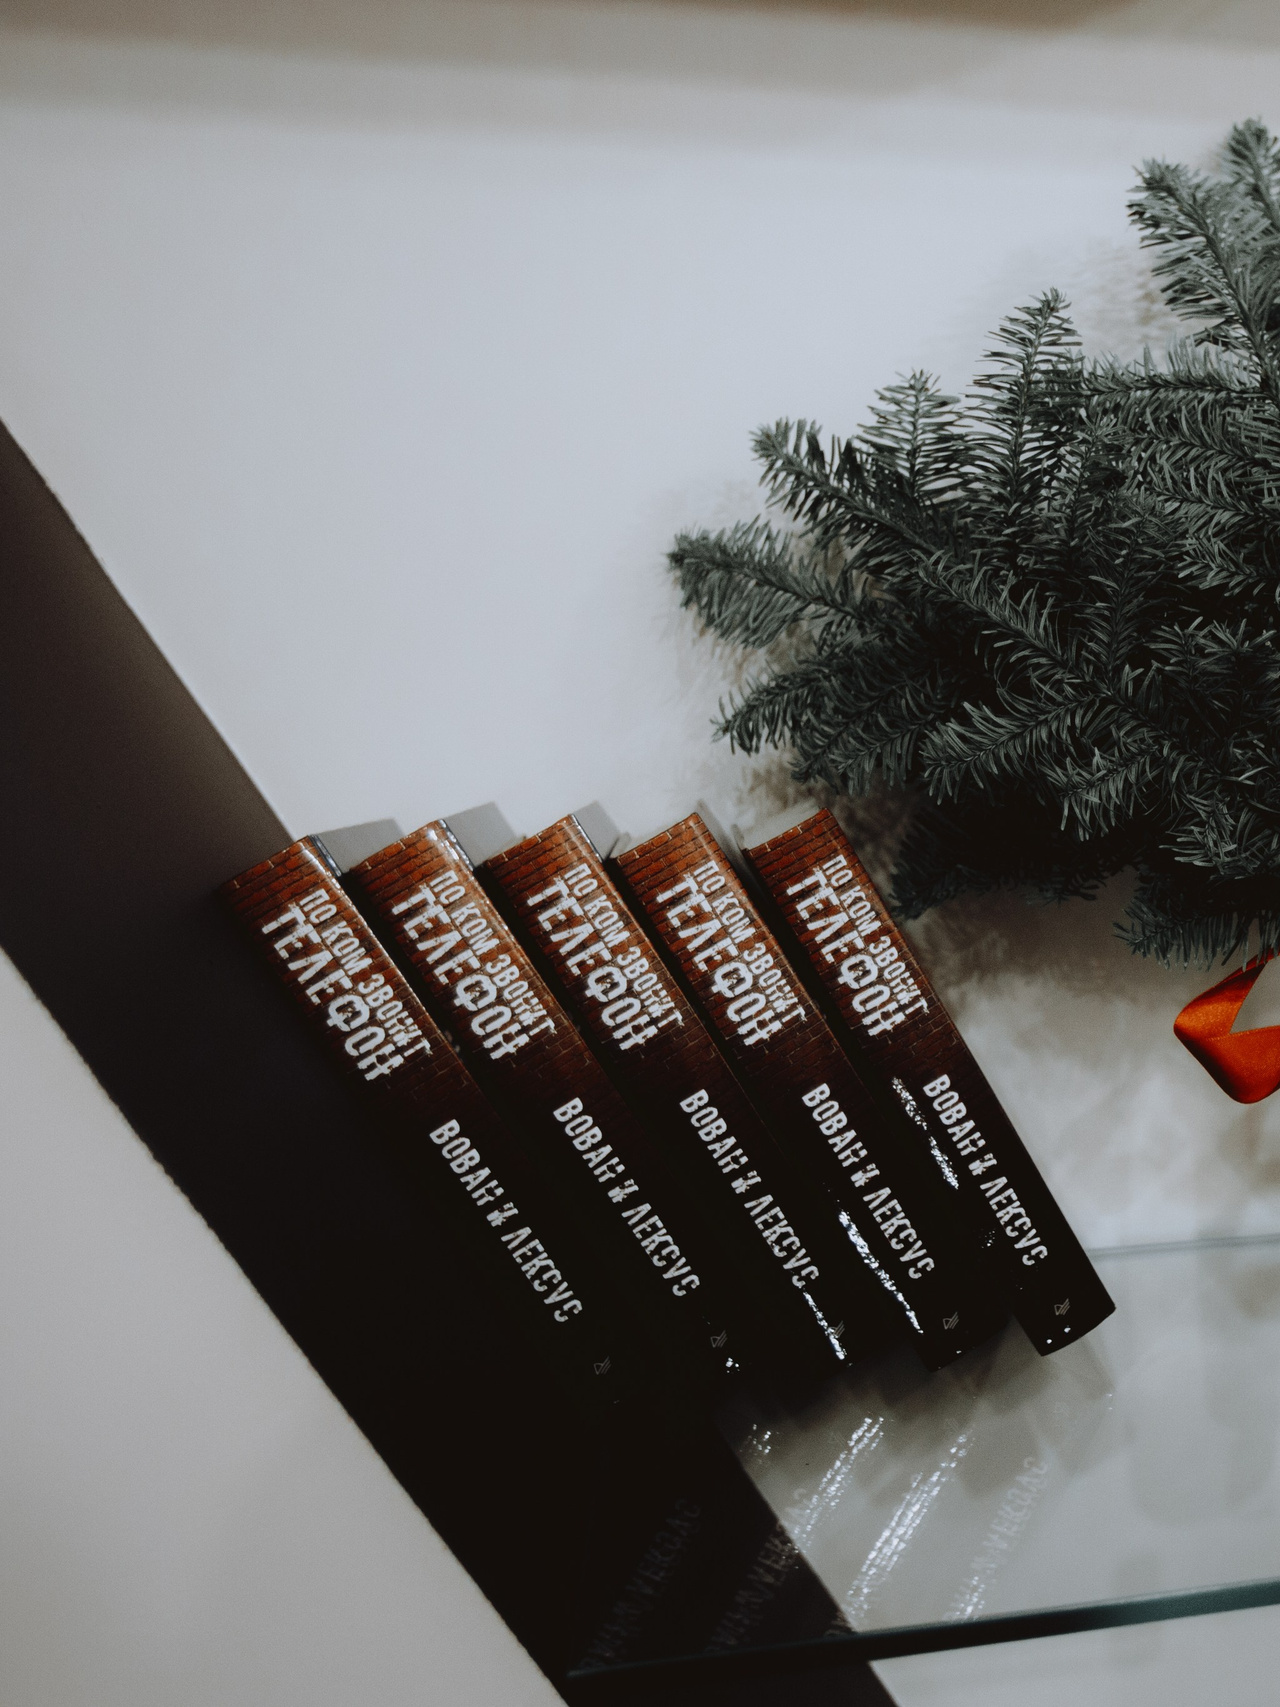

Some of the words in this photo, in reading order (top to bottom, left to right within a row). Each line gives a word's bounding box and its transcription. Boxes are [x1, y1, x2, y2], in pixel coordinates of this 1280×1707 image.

[300, 888, 337, 923] ПО
[321, 921, 373, 975] КОМ
[358, 973, 433, 1057] ЗВОНИТ
[392, 882, 530, 1060] ТЕЛЕФОН
[430, 870, 466, 905] ПО
[451, 902, 500, 956] КОМ
[485, 954, 557, 1037] ЗВОНИТ
[527, 875, 659, 1050] ТЕЛЕФОН
[564, 863, 598, 897] ПО
[584, 894, 631, 948] КОМ
[616, 946, 685, 1027] ЗВОНИТ
[656, 872, 783, 1046] ТЕЛЕФОН
[693, 860, 726, 893] ПО
[712, 892, 756, 944] КОМ
[743, 942, 807, 1023] ЗВОНИТ
[786, 866, 906, 1036] ТЕЛЕФОН
[822, 854, 853, 887] ПО
[840, 885, 882, 937] КОМ
[868, 935, 930, 1015] ЗВОНИТ
[262, 902, 404, 1081] ТЕЛЕФОН
[553, 1097, 626, 1183] ВОВАН
[679, 1089, 749, 1174] ВОВАН
[801, 1083, 868, 1168] ВОВАН
[923, 1074, 986, 1156] ВОВАН
[429, 1118, 504, 1206] ВОВАН
[607, 1178, 640, 1203] И
[731, 1170, 762, 1194] И
[850, 1163, 880, 1187] И
[968, 1152, 997, 1176] И
[486, 1201, 519, 1227] И
[621, 1203, 700, 1296] ЛЕКСУС
[744, 1194, 820, 1289] ЛЕКСУС
[863, 1187, 935, 1279] ЛЕКСУС
[980, 1176, 1048, 1266] ЛЕКСУС
[501, 1226, 583, 1322] ЛЕКСУС
